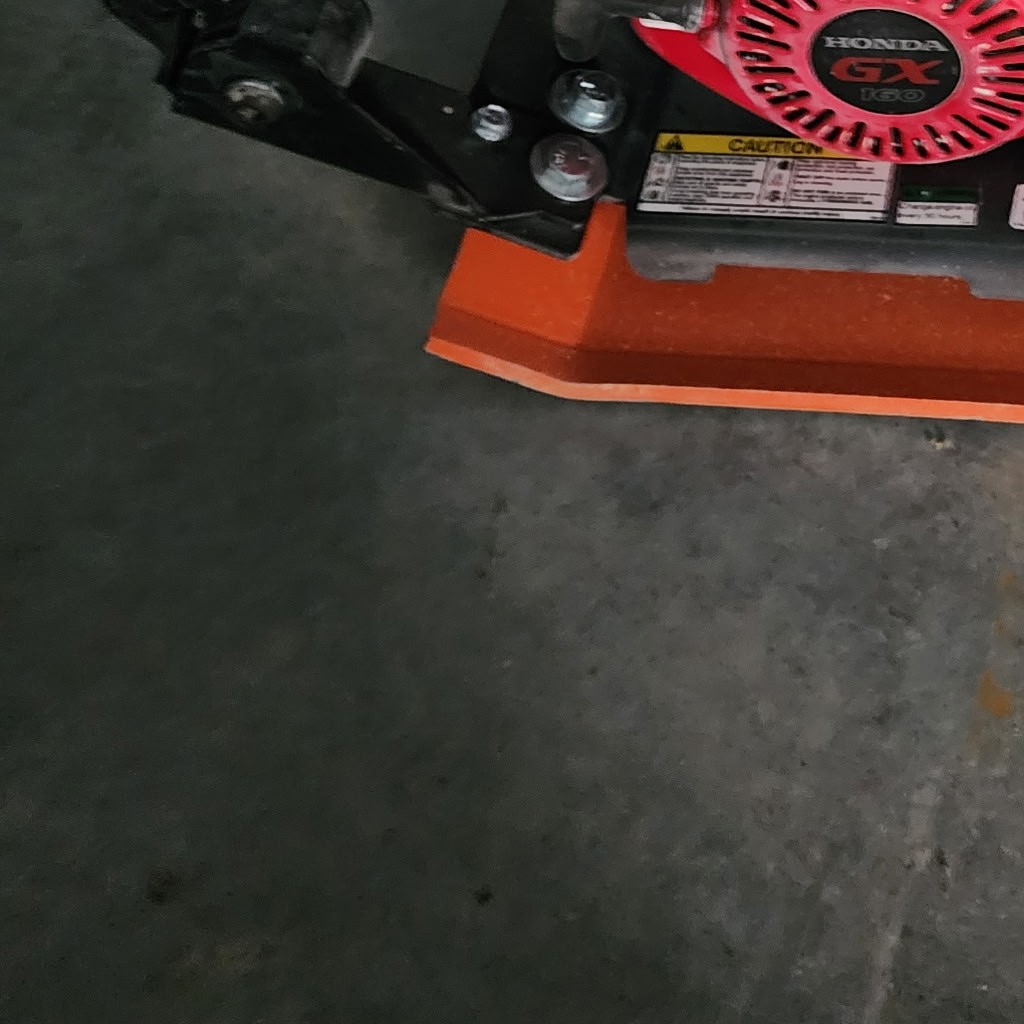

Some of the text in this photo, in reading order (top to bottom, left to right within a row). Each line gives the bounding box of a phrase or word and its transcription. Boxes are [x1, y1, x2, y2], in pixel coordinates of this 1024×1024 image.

[822, 37, 949, 53] HONDA
[831, 58, 943, 85] GX
[727, 137, 823, 155] CAUTION
